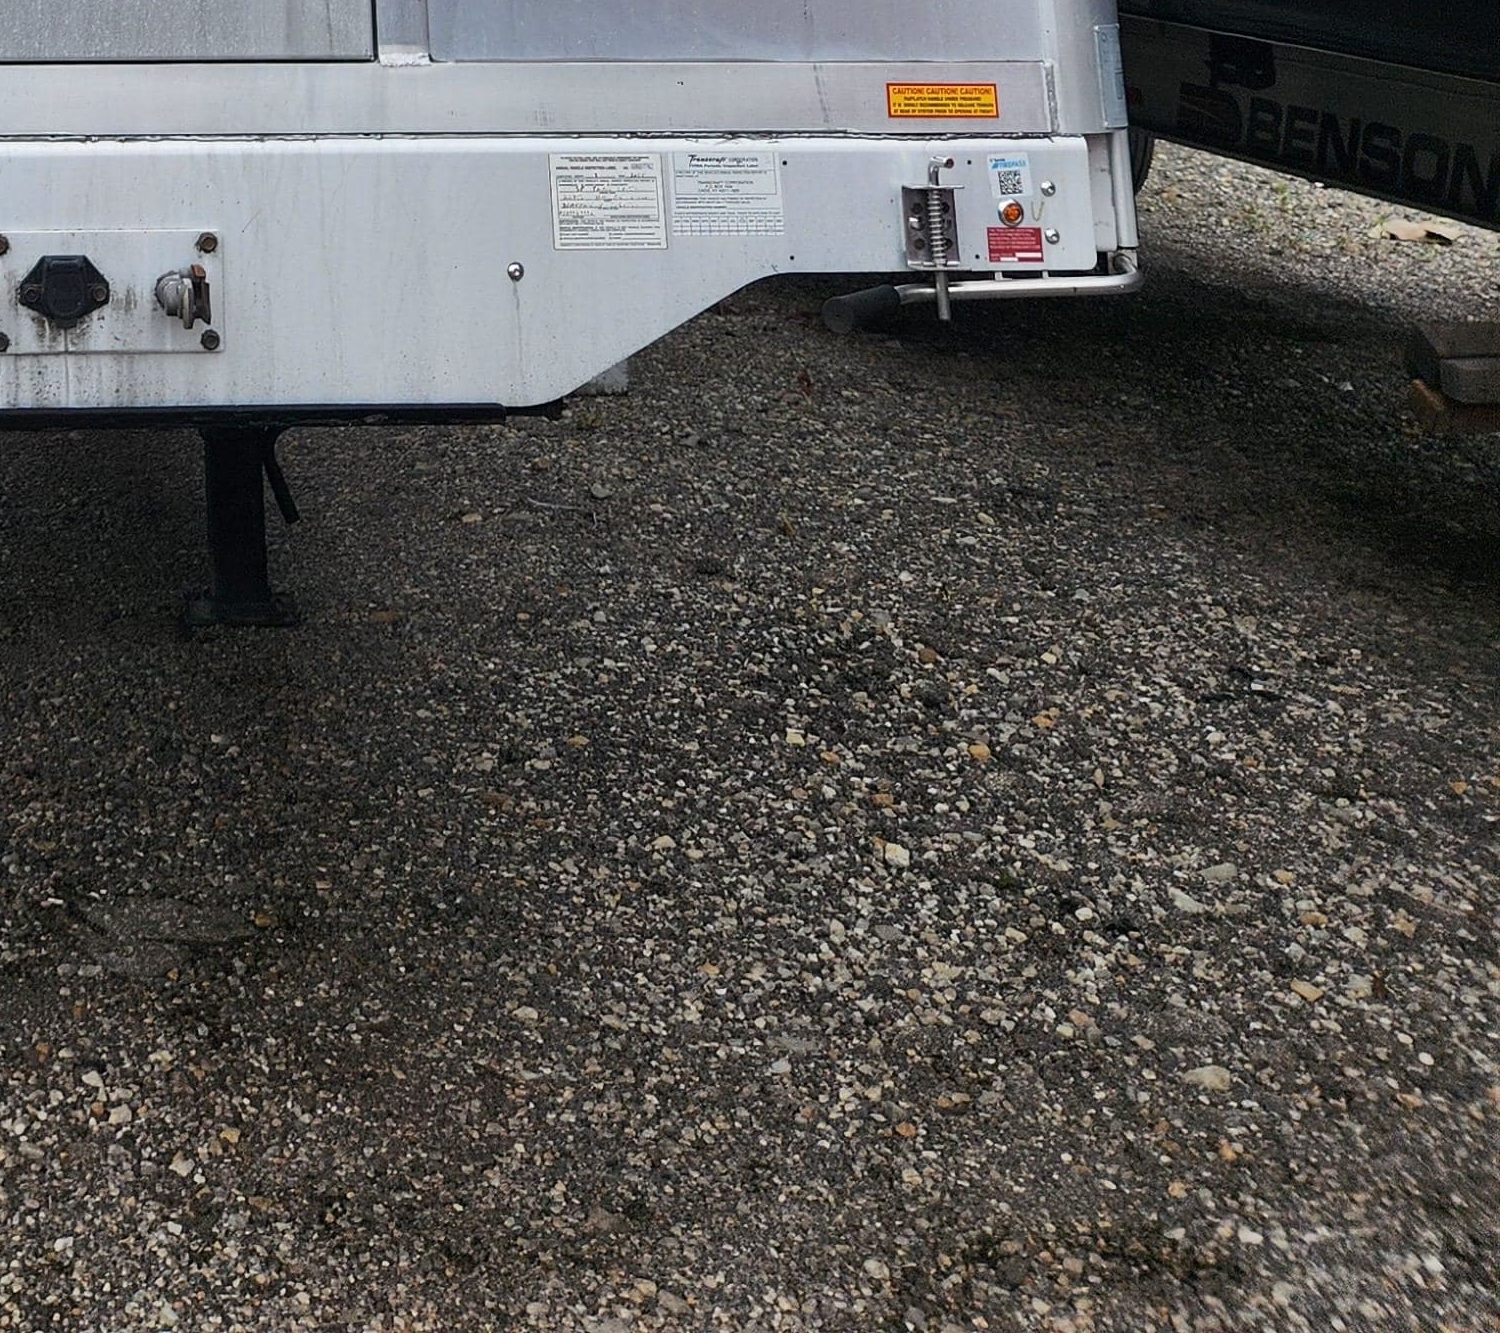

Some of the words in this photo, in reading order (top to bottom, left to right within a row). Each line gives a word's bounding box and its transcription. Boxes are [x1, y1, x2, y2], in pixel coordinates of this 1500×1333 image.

[892, 87, 924, 95] CAUTION!
[926, 87, 958, 95] CAUTION!
[959, 87, 992, 95] CAUTION!
[1247, 96, 1500, 222] BENSON
